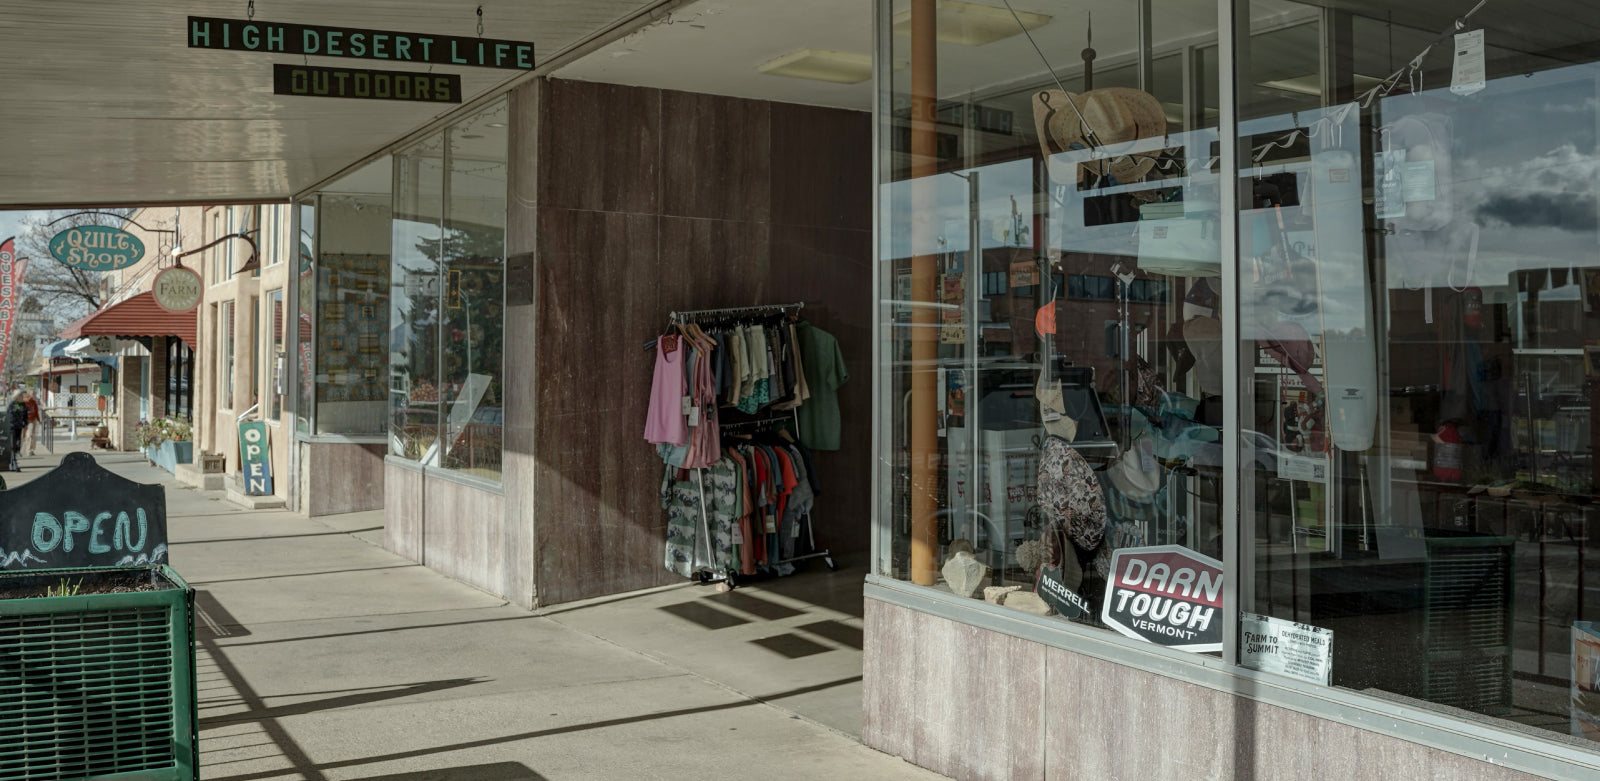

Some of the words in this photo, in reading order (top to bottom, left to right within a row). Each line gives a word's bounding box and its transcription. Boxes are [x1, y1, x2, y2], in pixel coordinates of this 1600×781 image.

[192, 21, 284, 51] HIGH
[303, 29, 434, 61] DESERT
[451, 40, 533, 68] LIFE
[291, 69, 450, 100] OUTDOORS
[66, 229, 129, 252] QUILT
[160, 282, 197, 295] FARM
[244, 428, 265, 493] OPEN
[30, 507, 148, 554] OPEN
[1042, 574, 1090, 614] MERRELL
[1121, 558, 1223, 602] DARN
[1116, 589, 1214, 632] TOUGH
[1132, 618, 1195, 640] VERMONT
[1244, 631, 1267, 644] FARM
[1269, 635, 1278, 644] TO
[1246, 643, 1279, 654] SUMMIT
